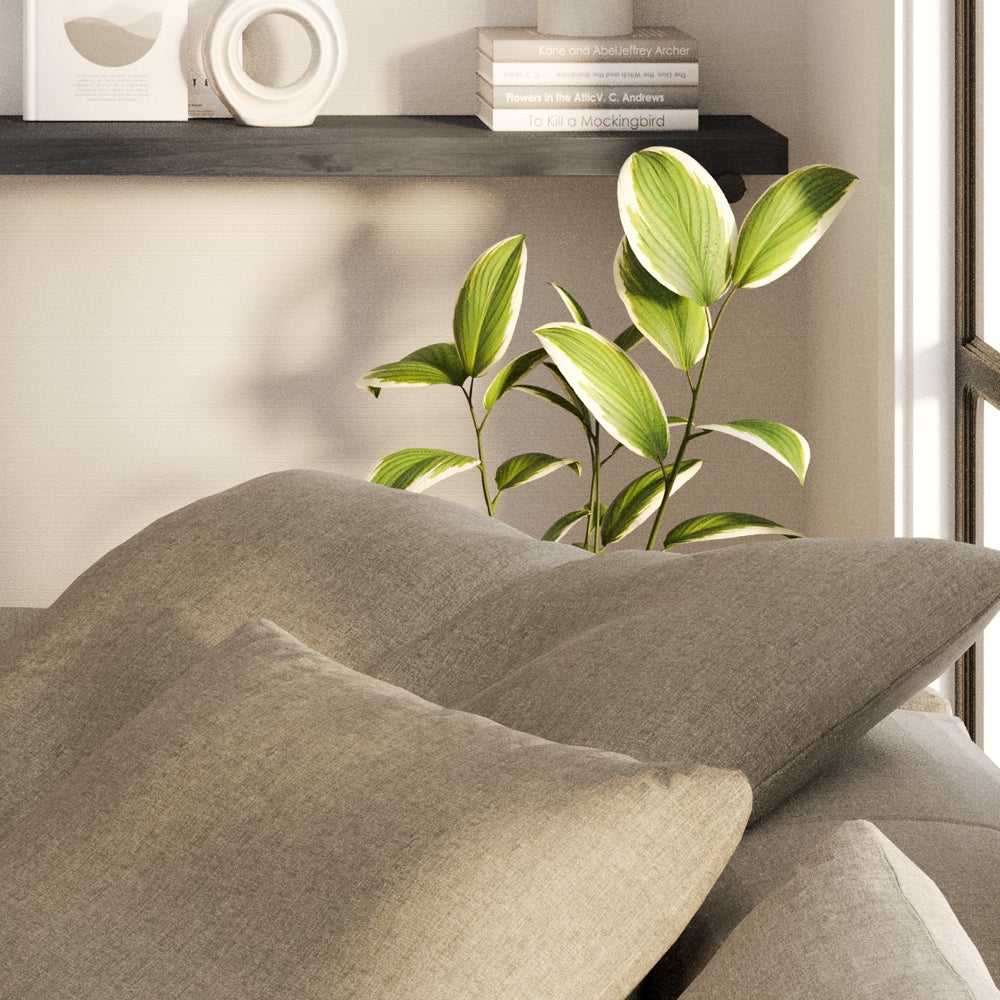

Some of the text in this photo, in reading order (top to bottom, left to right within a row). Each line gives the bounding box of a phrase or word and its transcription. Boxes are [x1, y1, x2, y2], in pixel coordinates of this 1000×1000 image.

[538, 45, 566, 56] Kane
[568, 45, 590, 56] and
[654, 45, 690, 55] Archer
[506, 92, 542, 102] Flowers
[555, 92, 571, 102] the
[608, 92, 619, 102] C.
[622, 92, 664, 102] Andrews
[528, 115, 665, 130] To Kill a Mockingbird
